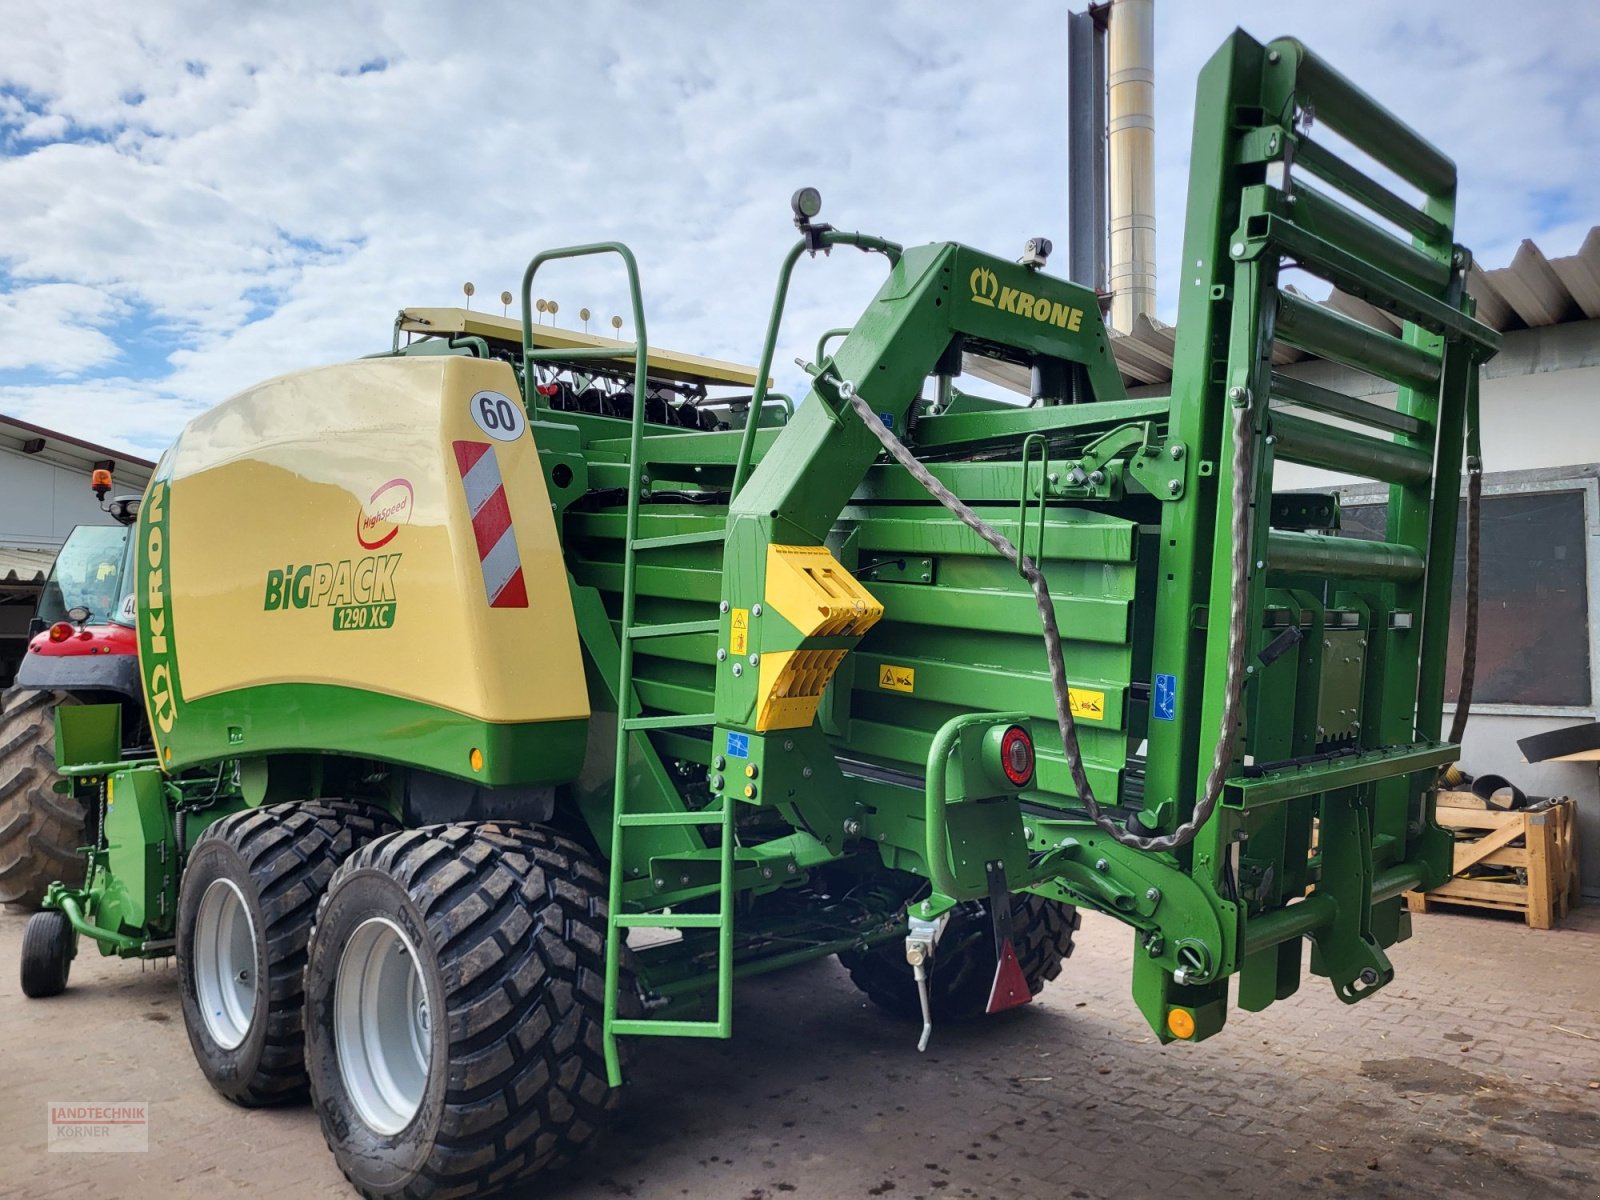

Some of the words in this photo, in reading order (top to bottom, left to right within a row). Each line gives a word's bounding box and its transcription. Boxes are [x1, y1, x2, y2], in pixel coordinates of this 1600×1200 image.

[998, 286, 1084, 332] KRONE
[479, 397, 516, 432] 60
[363, 495, 408, 530] HighSpeed
[147, 479, 168, 654] KRON
[338, 607, 368, 628] 1290
[369, 605, 389, 627] XC
